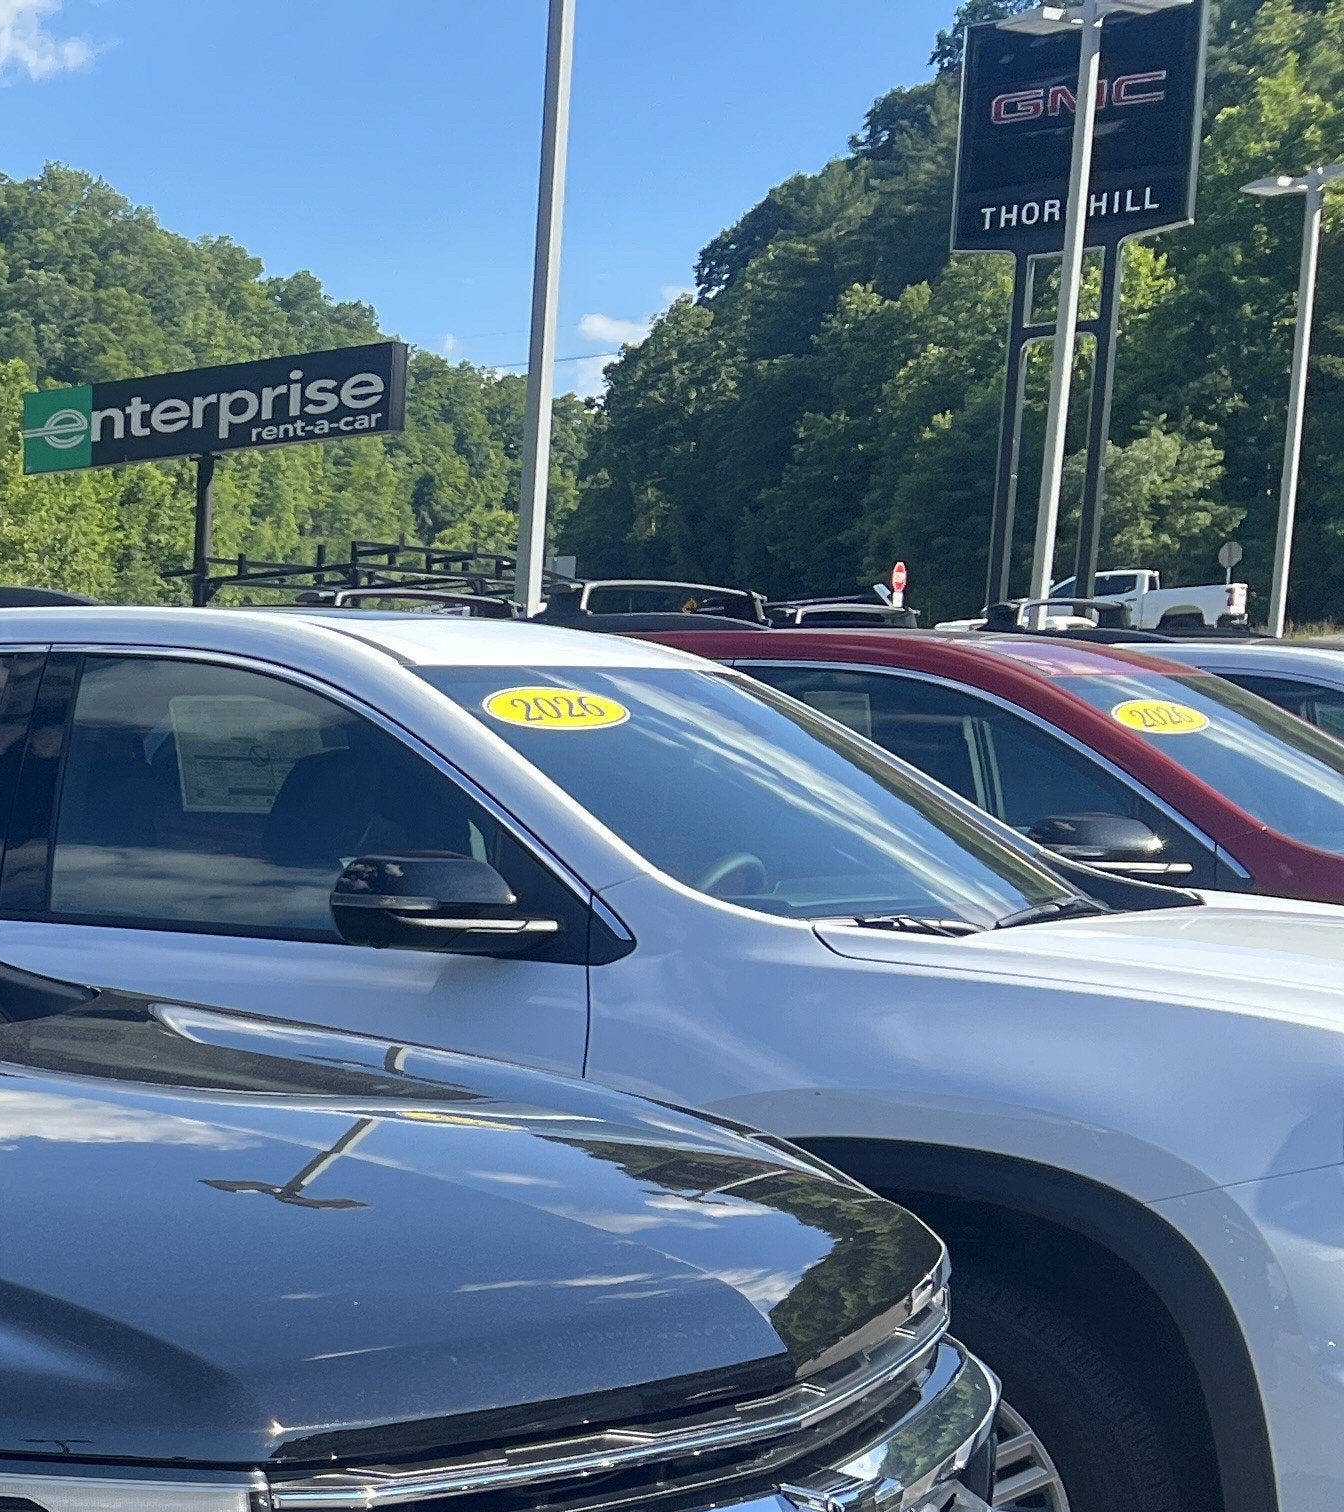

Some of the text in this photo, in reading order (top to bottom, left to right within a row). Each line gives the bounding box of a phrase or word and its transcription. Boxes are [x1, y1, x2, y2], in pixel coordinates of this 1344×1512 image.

[990, 69, 1167, 125] GMC
[980, 186, 1160, 232] THORHILL
[24, 368, 386, 450] enterprise
[250, 411, 383, 443] rent-a-car
[510, 695, 605, 722] 2026
[1129, 706, 1195, 728] 2026
